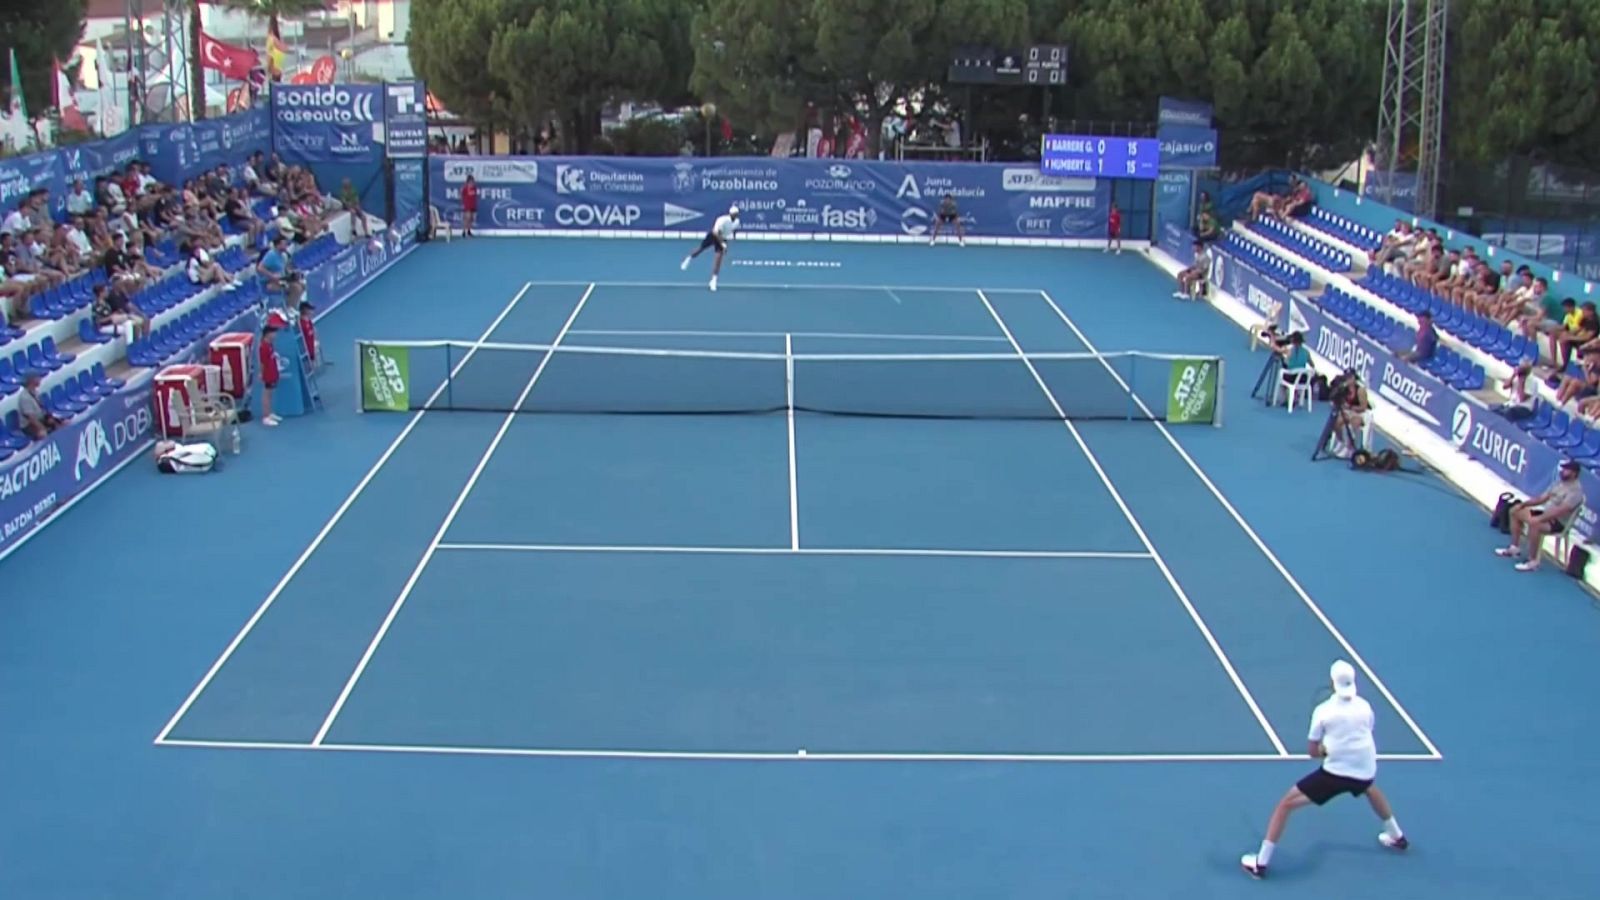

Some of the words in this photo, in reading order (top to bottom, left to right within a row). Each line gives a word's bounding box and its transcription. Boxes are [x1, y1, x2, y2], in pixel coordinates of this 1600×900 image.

[277, 85, 350, 106] sonido
[277, 107, 352, 122] caseauto
[1098, 140, 1105, 154] 0
[1128, 142, 1138, 155] 15
[1158, 139, 1201, 155] cajasur
[766, 167, 777, 177] de
[1098, 160, 1103, 172] 1
[1127, 161, 1136, 174] 15
[589, 171, 644, 183] Diputación
[702, 178, 778, 191] Pozoblanco
[924, 177, 952, 187] Junta
[923, 187, 936, 196] de
[937, 186, 985, 197] Andalucía
[1030, 196, 1096, 208] MAPFRE
[506, 207, 545, 220] RFET
[555, 203, 641, 226] COVAP
[822, 204, 867, 228] fast
[380, 354, 405, 394] ATP
[1173, 365, 1195, 408] ATP
[1383, 361, 1432, 407] Romar
